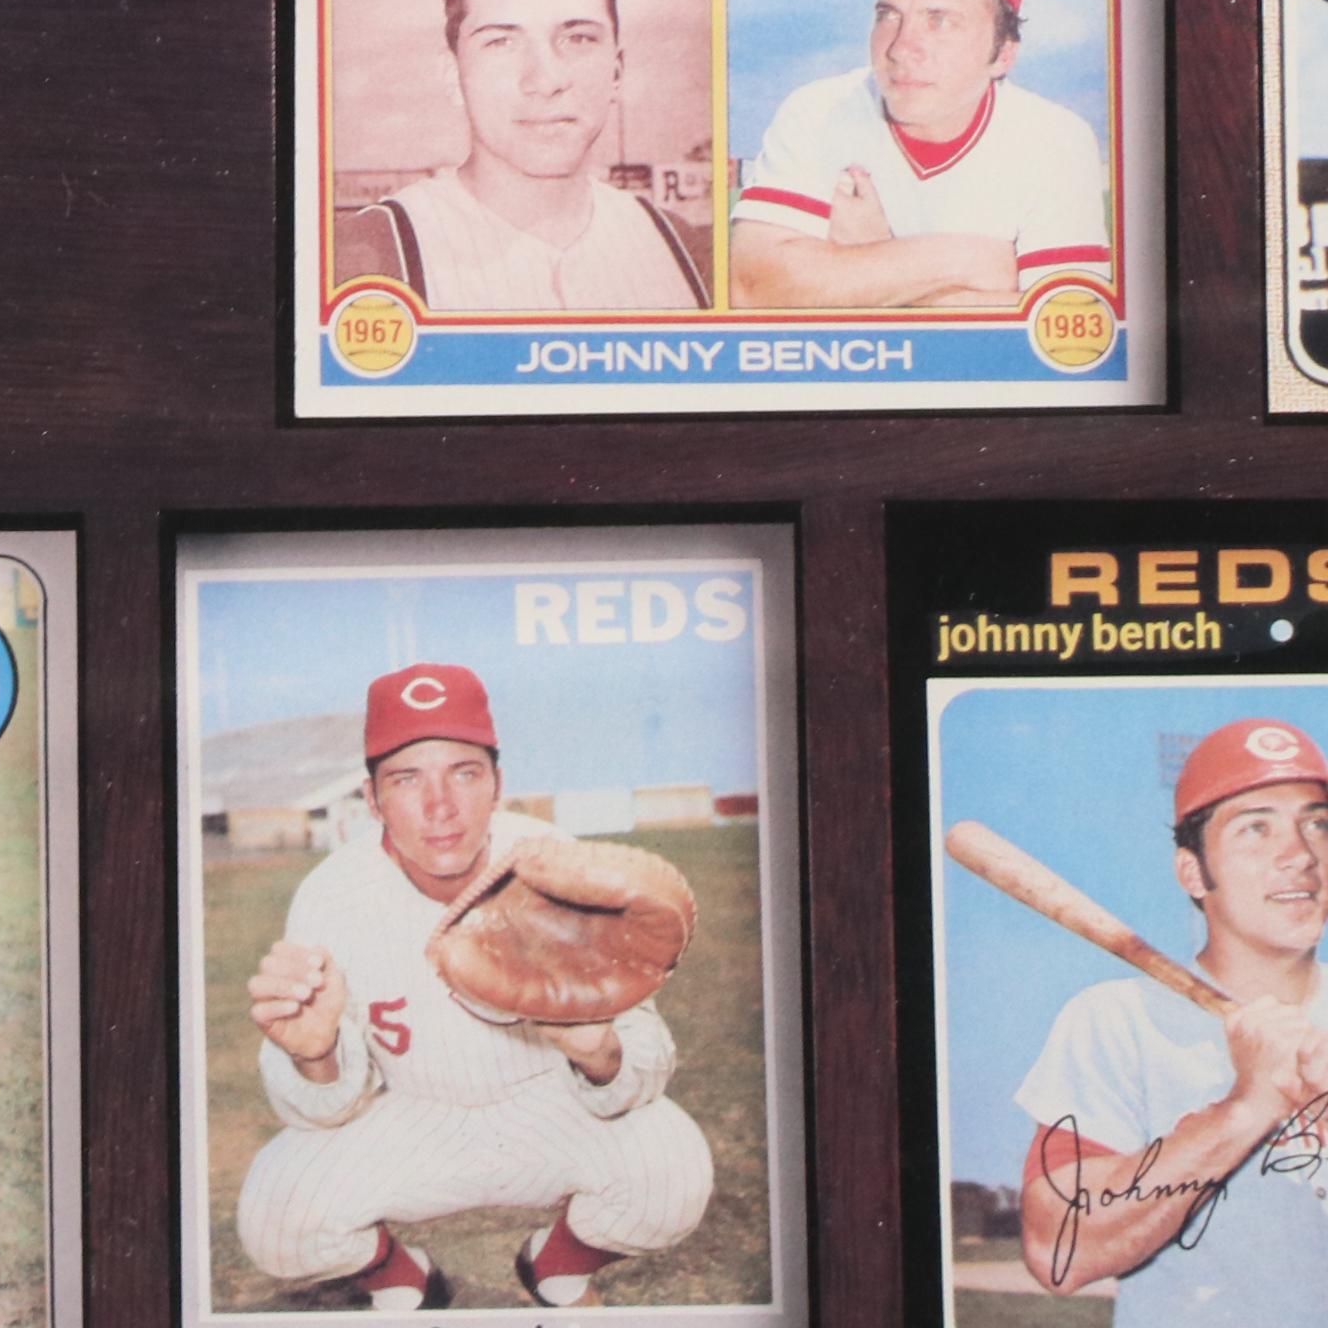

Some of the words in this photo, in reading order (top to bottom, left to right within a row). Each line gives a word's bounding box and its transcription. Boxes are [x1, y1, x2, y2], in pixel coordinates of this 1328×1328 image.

[342, 318, 404, 344] 1967
[1039, 313, 1105, 339] 1983
[515, 340, 725, 373] JOHNNY
[738, 339, 913, 372] BENCH
[514, 577, 748, 646] REDS
[937, 615, 1084, 662] johnny
[1092, 612, 1221, 652] bench
[368, 996, 412, 1057] 5
